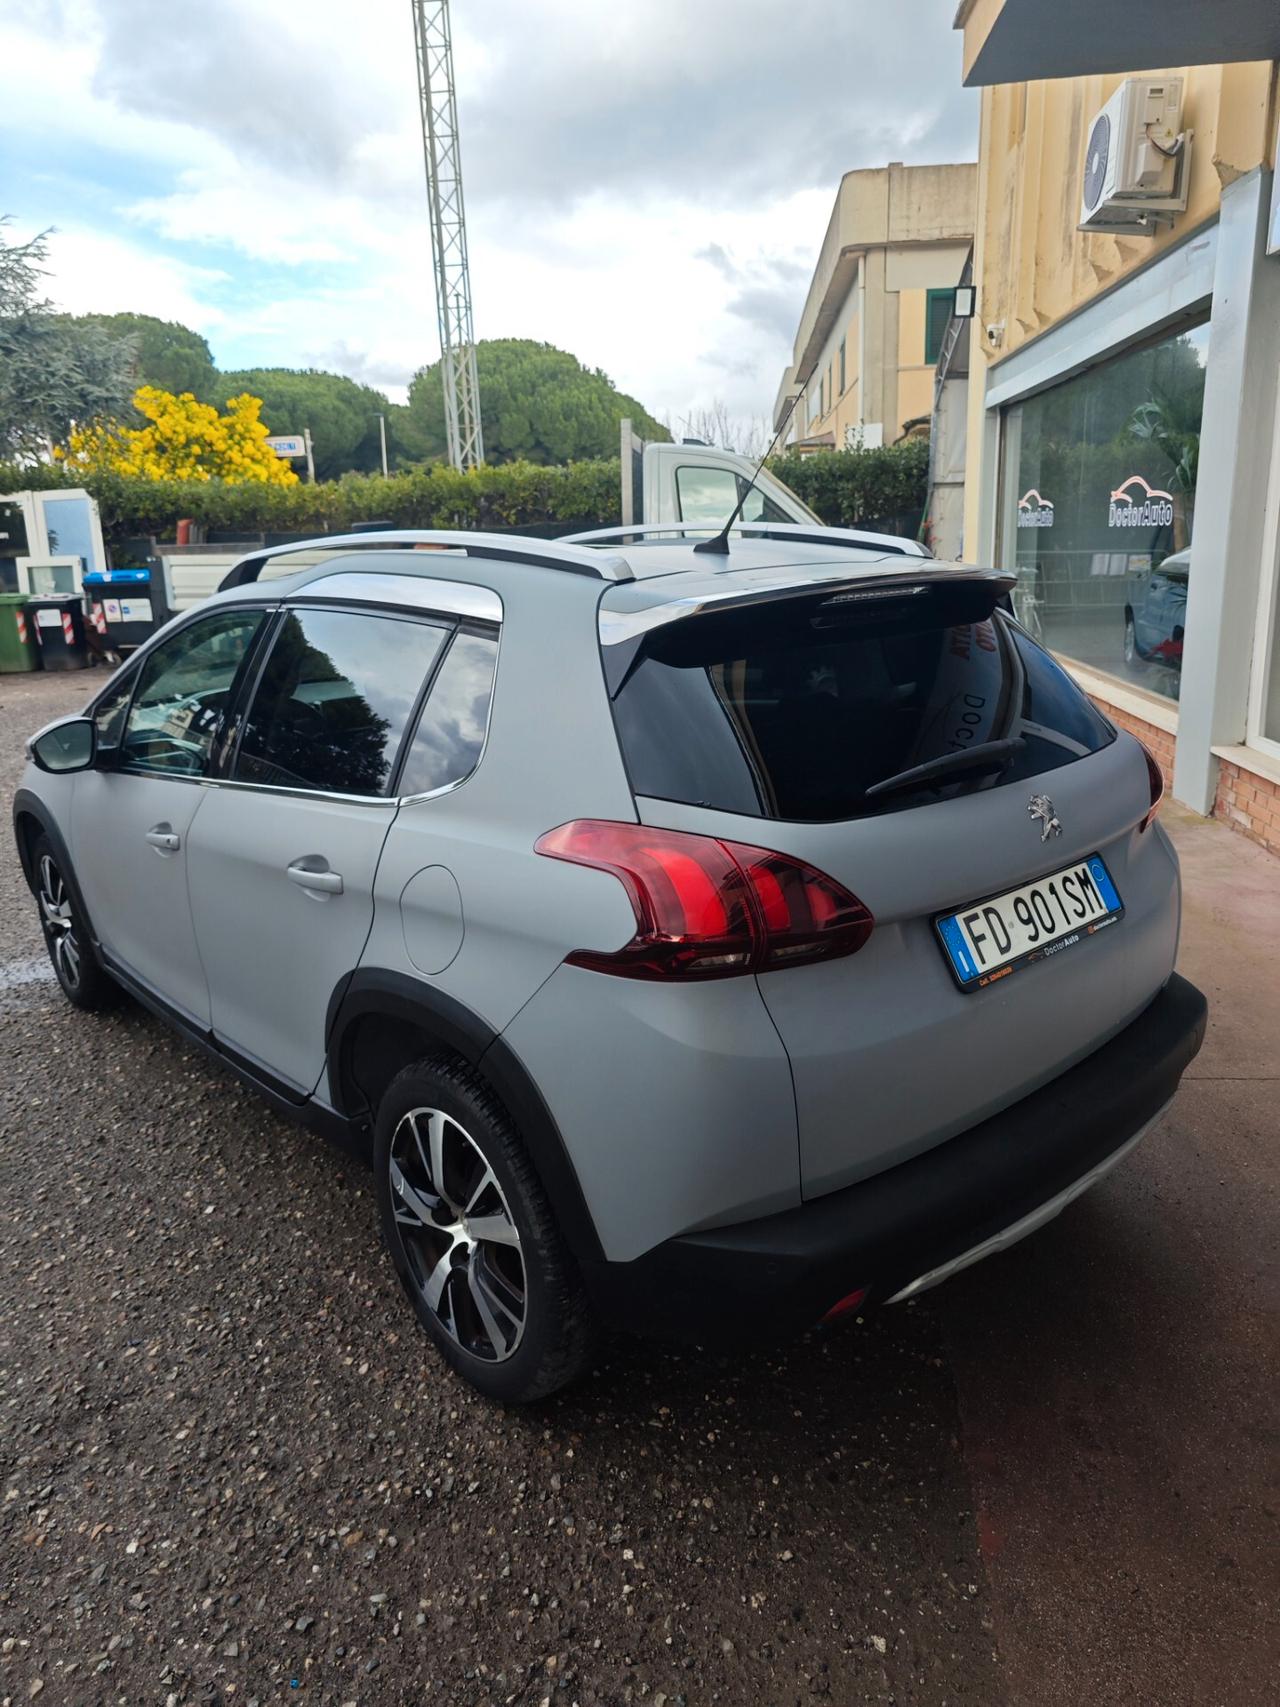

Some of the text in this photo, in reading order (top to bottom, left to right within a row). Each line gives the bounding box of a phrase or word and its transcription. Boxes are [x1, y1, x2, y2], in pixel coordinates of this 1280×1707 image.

[1108, 501, 1174, 528] DoctorAuto
[962, 906, 1012, 965] FD
[1043, 934, 1080, 957] DoctorAuto
